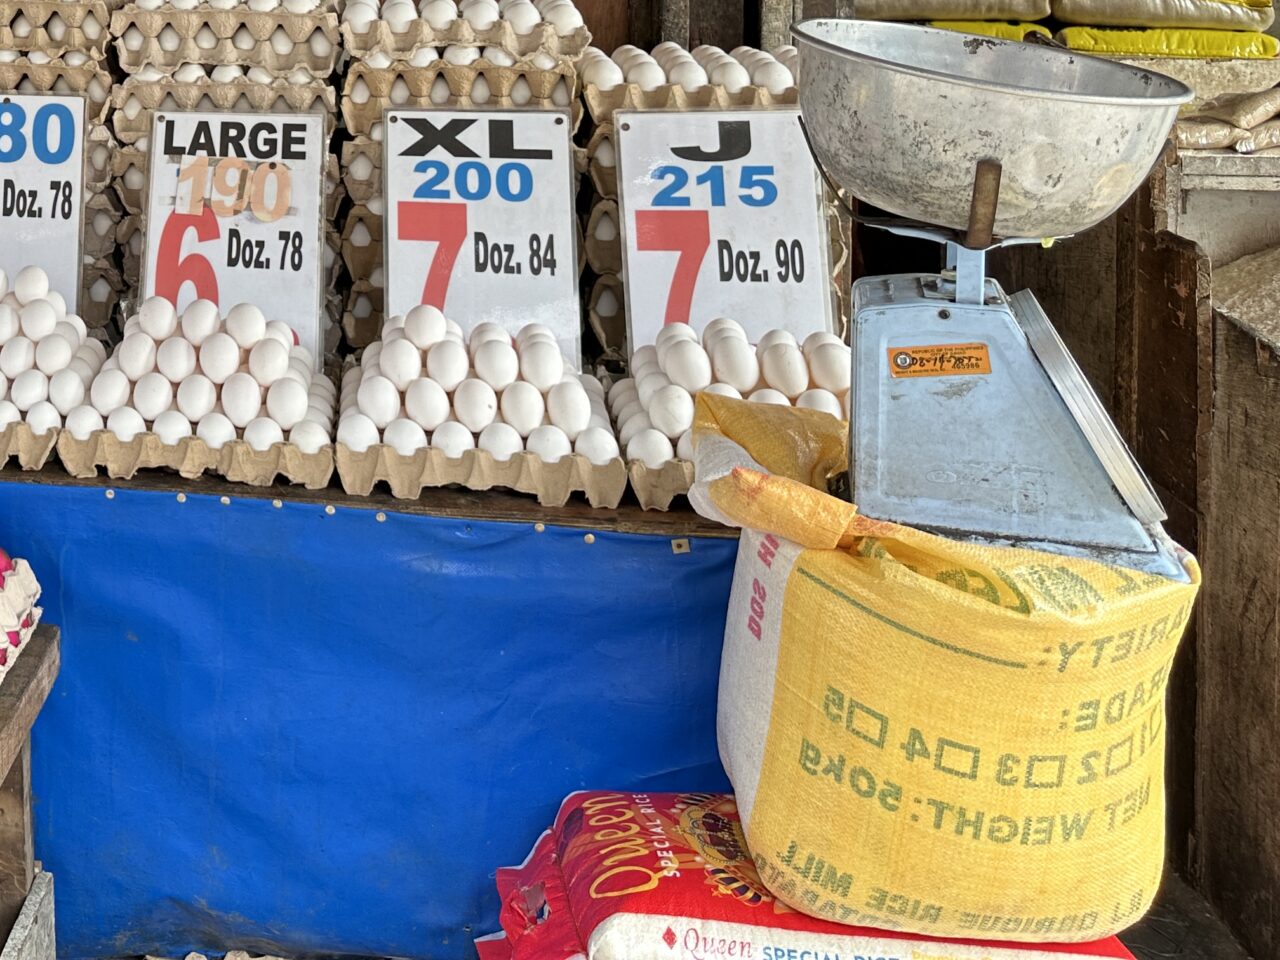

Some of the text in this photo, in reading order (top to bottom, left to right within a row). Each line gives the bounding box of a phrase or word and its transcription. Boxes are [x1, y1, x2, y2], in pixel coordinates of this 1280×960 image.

[163, 119, 307, 160] LARGE
[397, 117, 553, 160] XL
[670, 120, 752, 162] J
[2, 178, 73, 220] Doz. 78
[179, 155, 291, 223] 190
[412, 160, 533, 202] 200
[650, 165, 778, 208] 215
[154, 200, 220, 314] 6
[226, 227, 303, 271] Doz. 78
[397, 201, 467, 314] 7
[473, 231, 557, 276] Doz. 84
[635, 209, 711, 326] 7
[717, 238, 805, 283] Doz. 90
[581, 794, 675, 899] Queen
[632, 793, 680, 878] SPECIAL RICE
[683, 928, 753, 958] Queen
